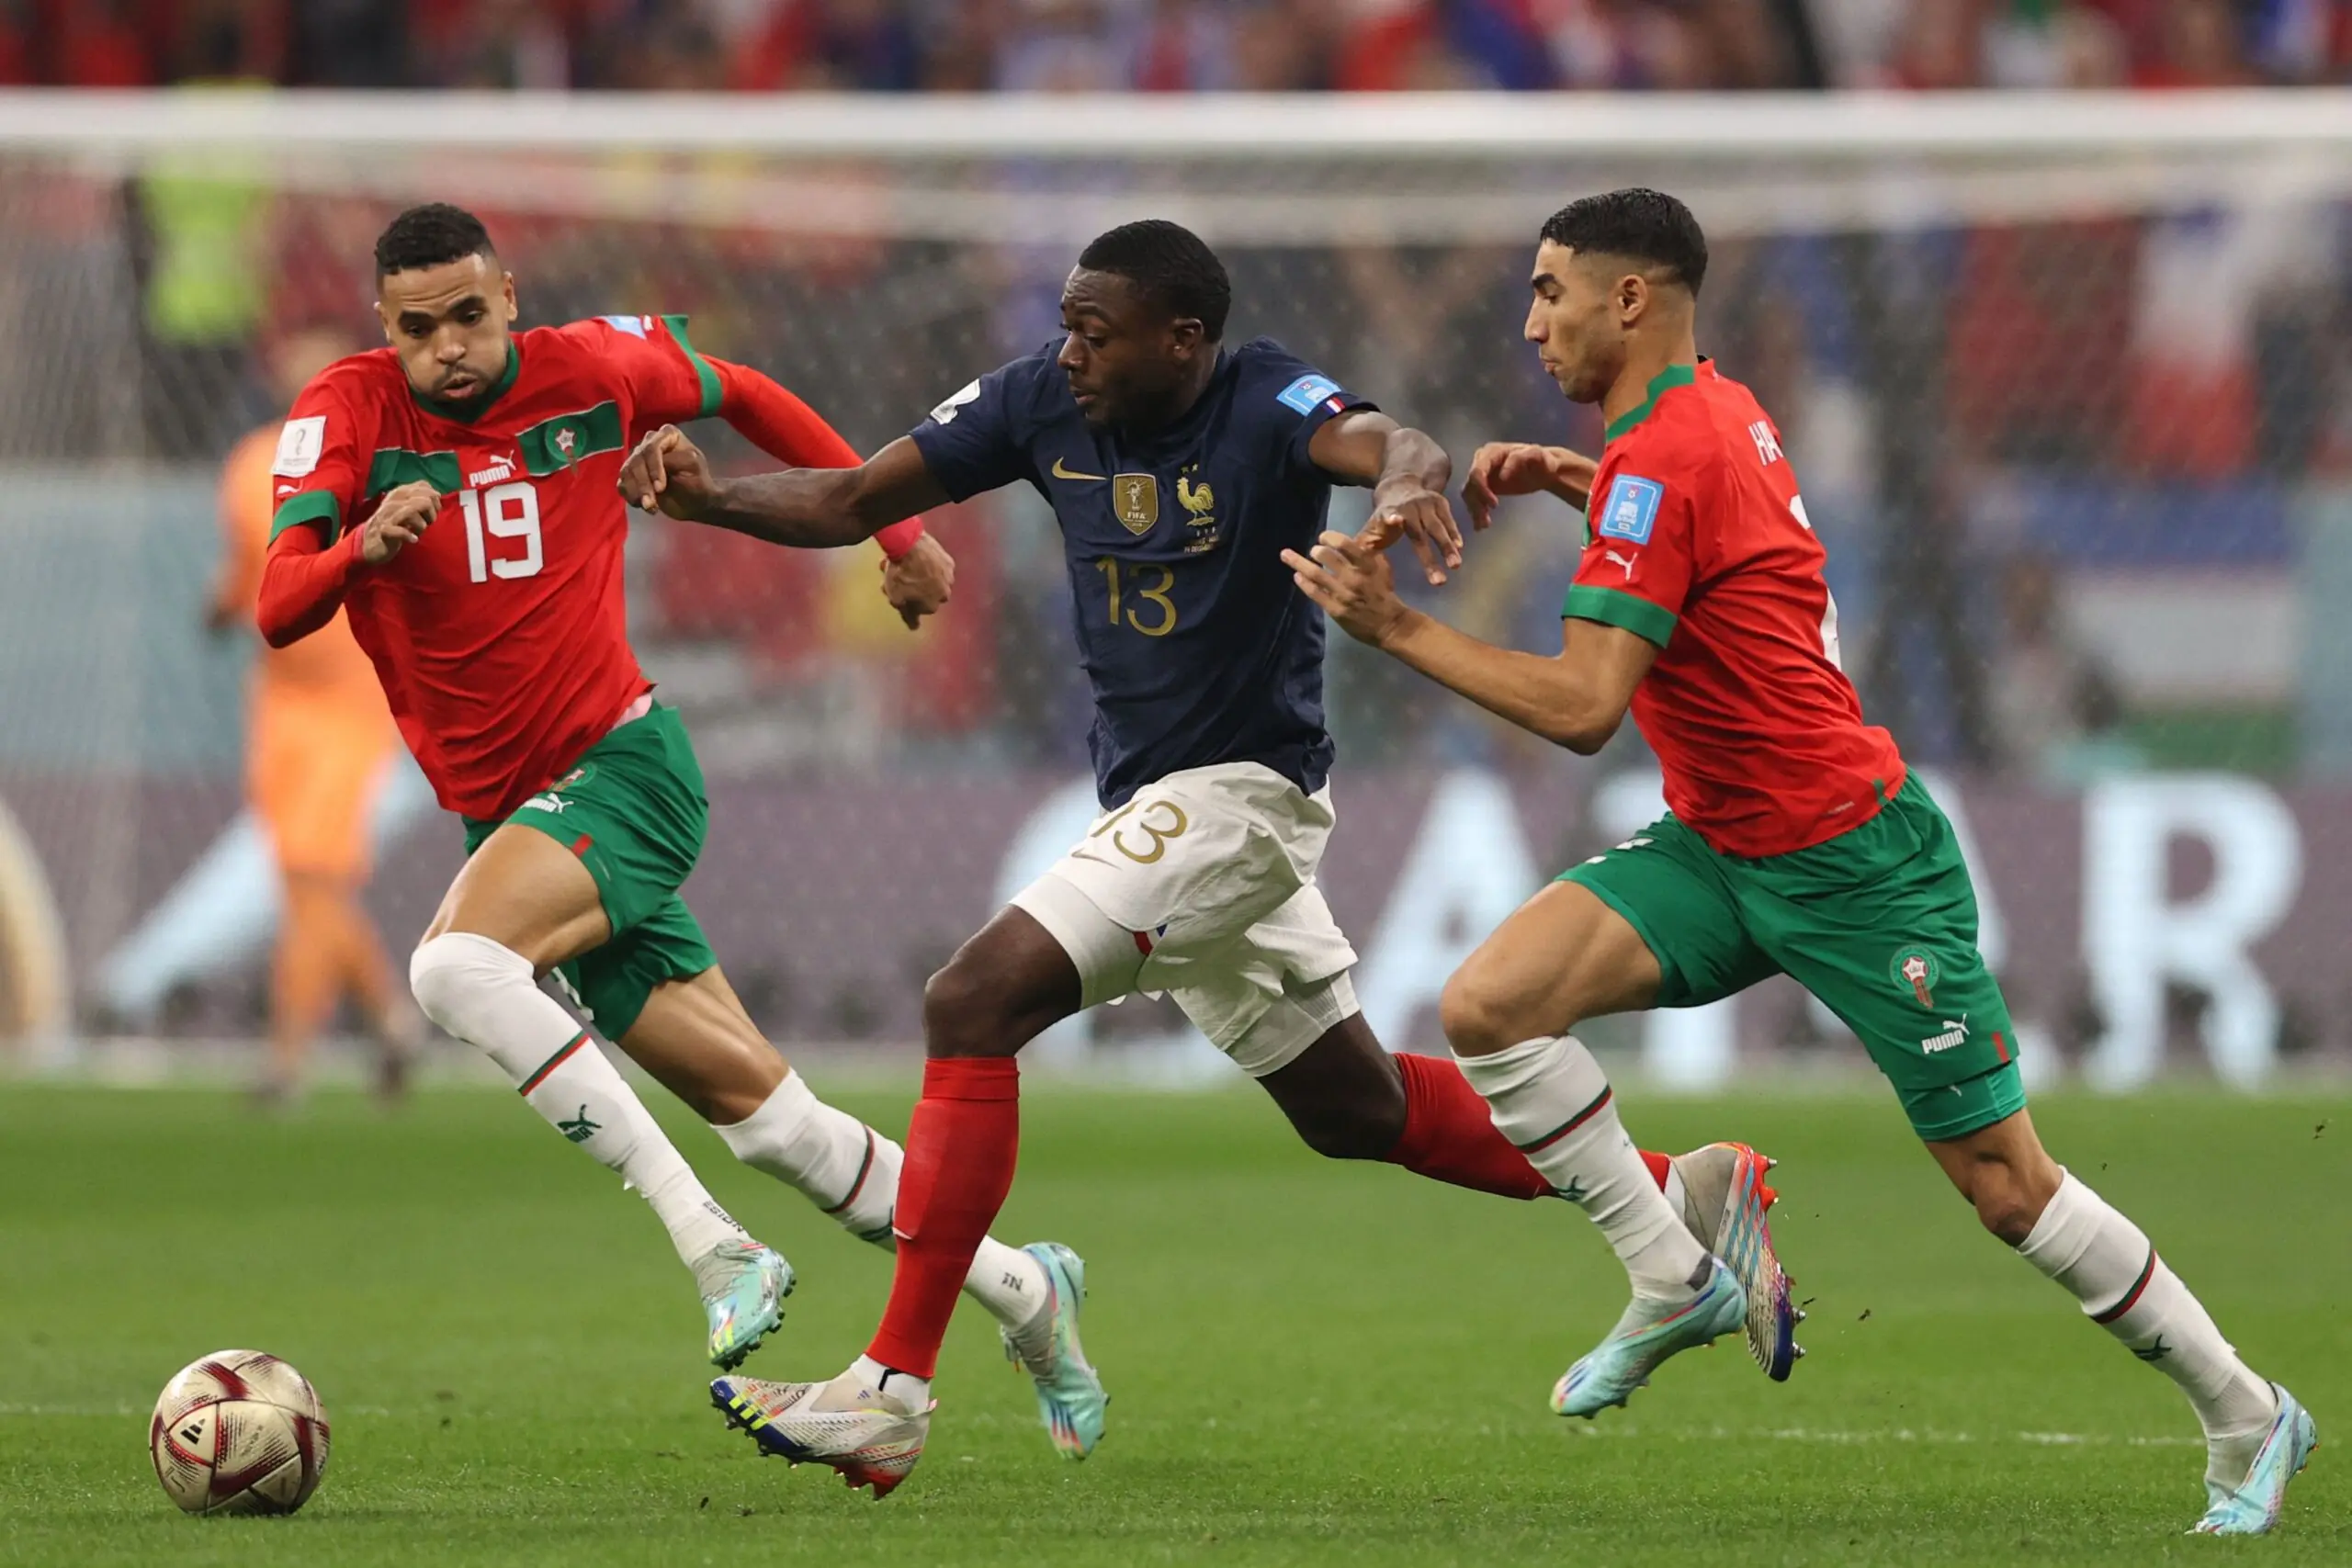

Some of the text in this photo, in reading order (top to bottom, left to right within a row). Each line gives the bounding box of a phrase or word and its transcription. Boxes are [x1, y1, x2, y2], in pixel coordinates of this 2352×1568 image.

[469, 464, 511, 488] PUMA
[459, 481, 544, 582] 19
[1095, 555, 1176, 636] 13
[1091, 798, 1187, 863] 13
[1922, 1030, 1964, 1055] PUMA
